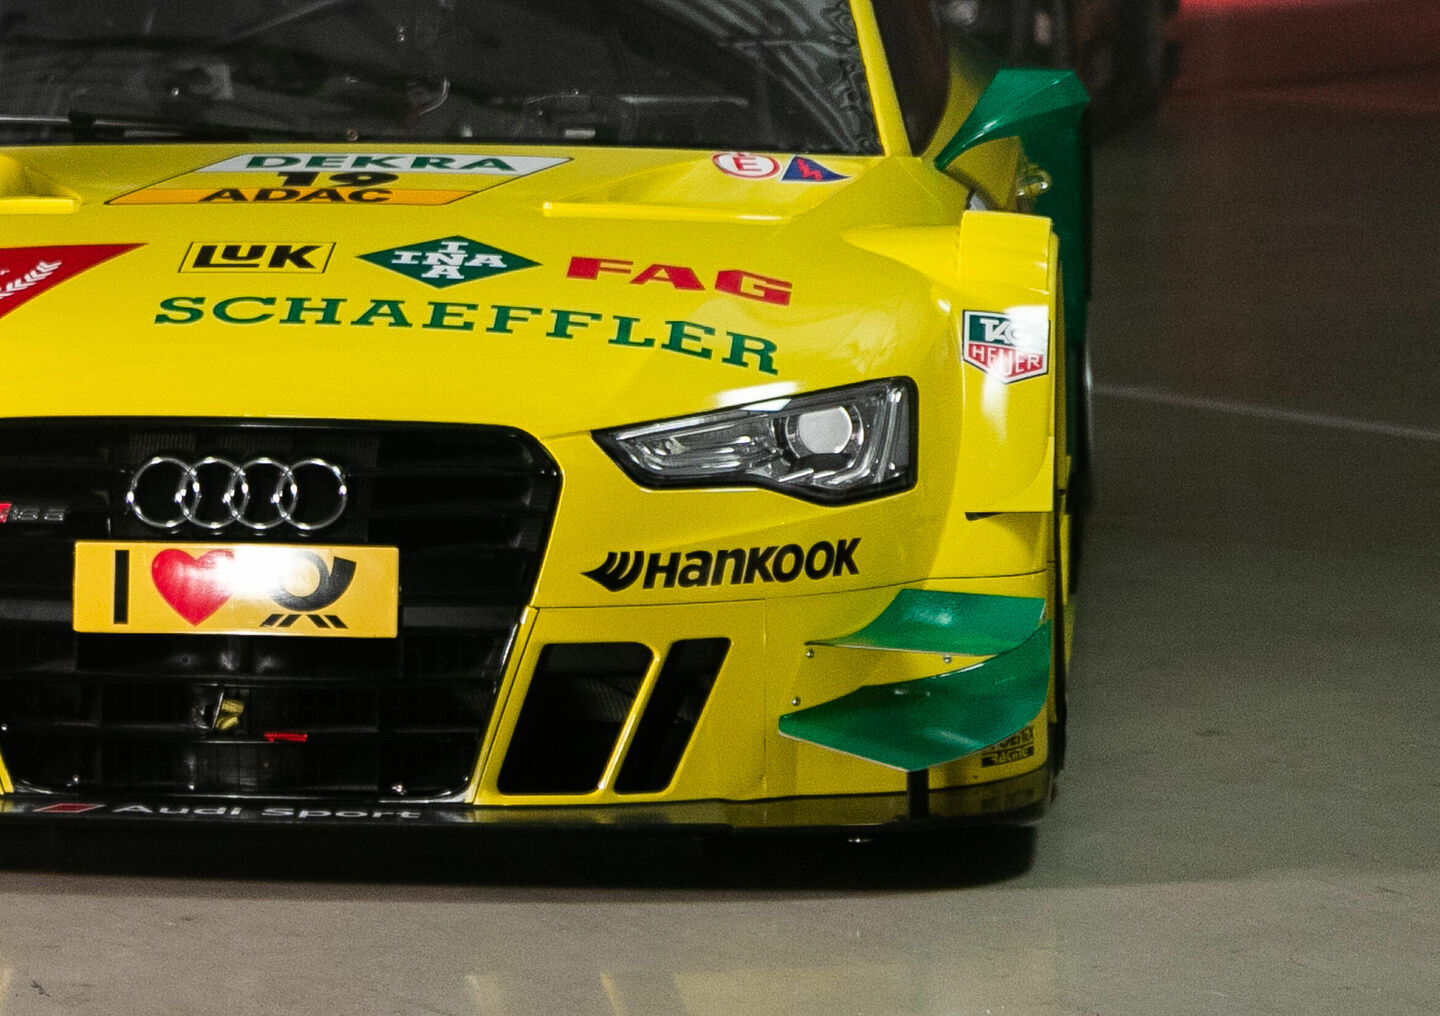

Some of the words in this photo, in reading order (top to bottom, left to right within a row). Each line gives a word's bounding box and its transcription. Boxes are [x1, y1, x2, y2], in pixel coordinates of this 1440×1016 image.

[245, 155, 517, 172] DEKRA
[277, 171, 400, 187] 19
[199, 187, 394, 203] ADAC
[566, 256, 792, 307] FAG
[155, 295, 780, 375] SCHAEFFLER
[112, 804, 243, 815] Audi
